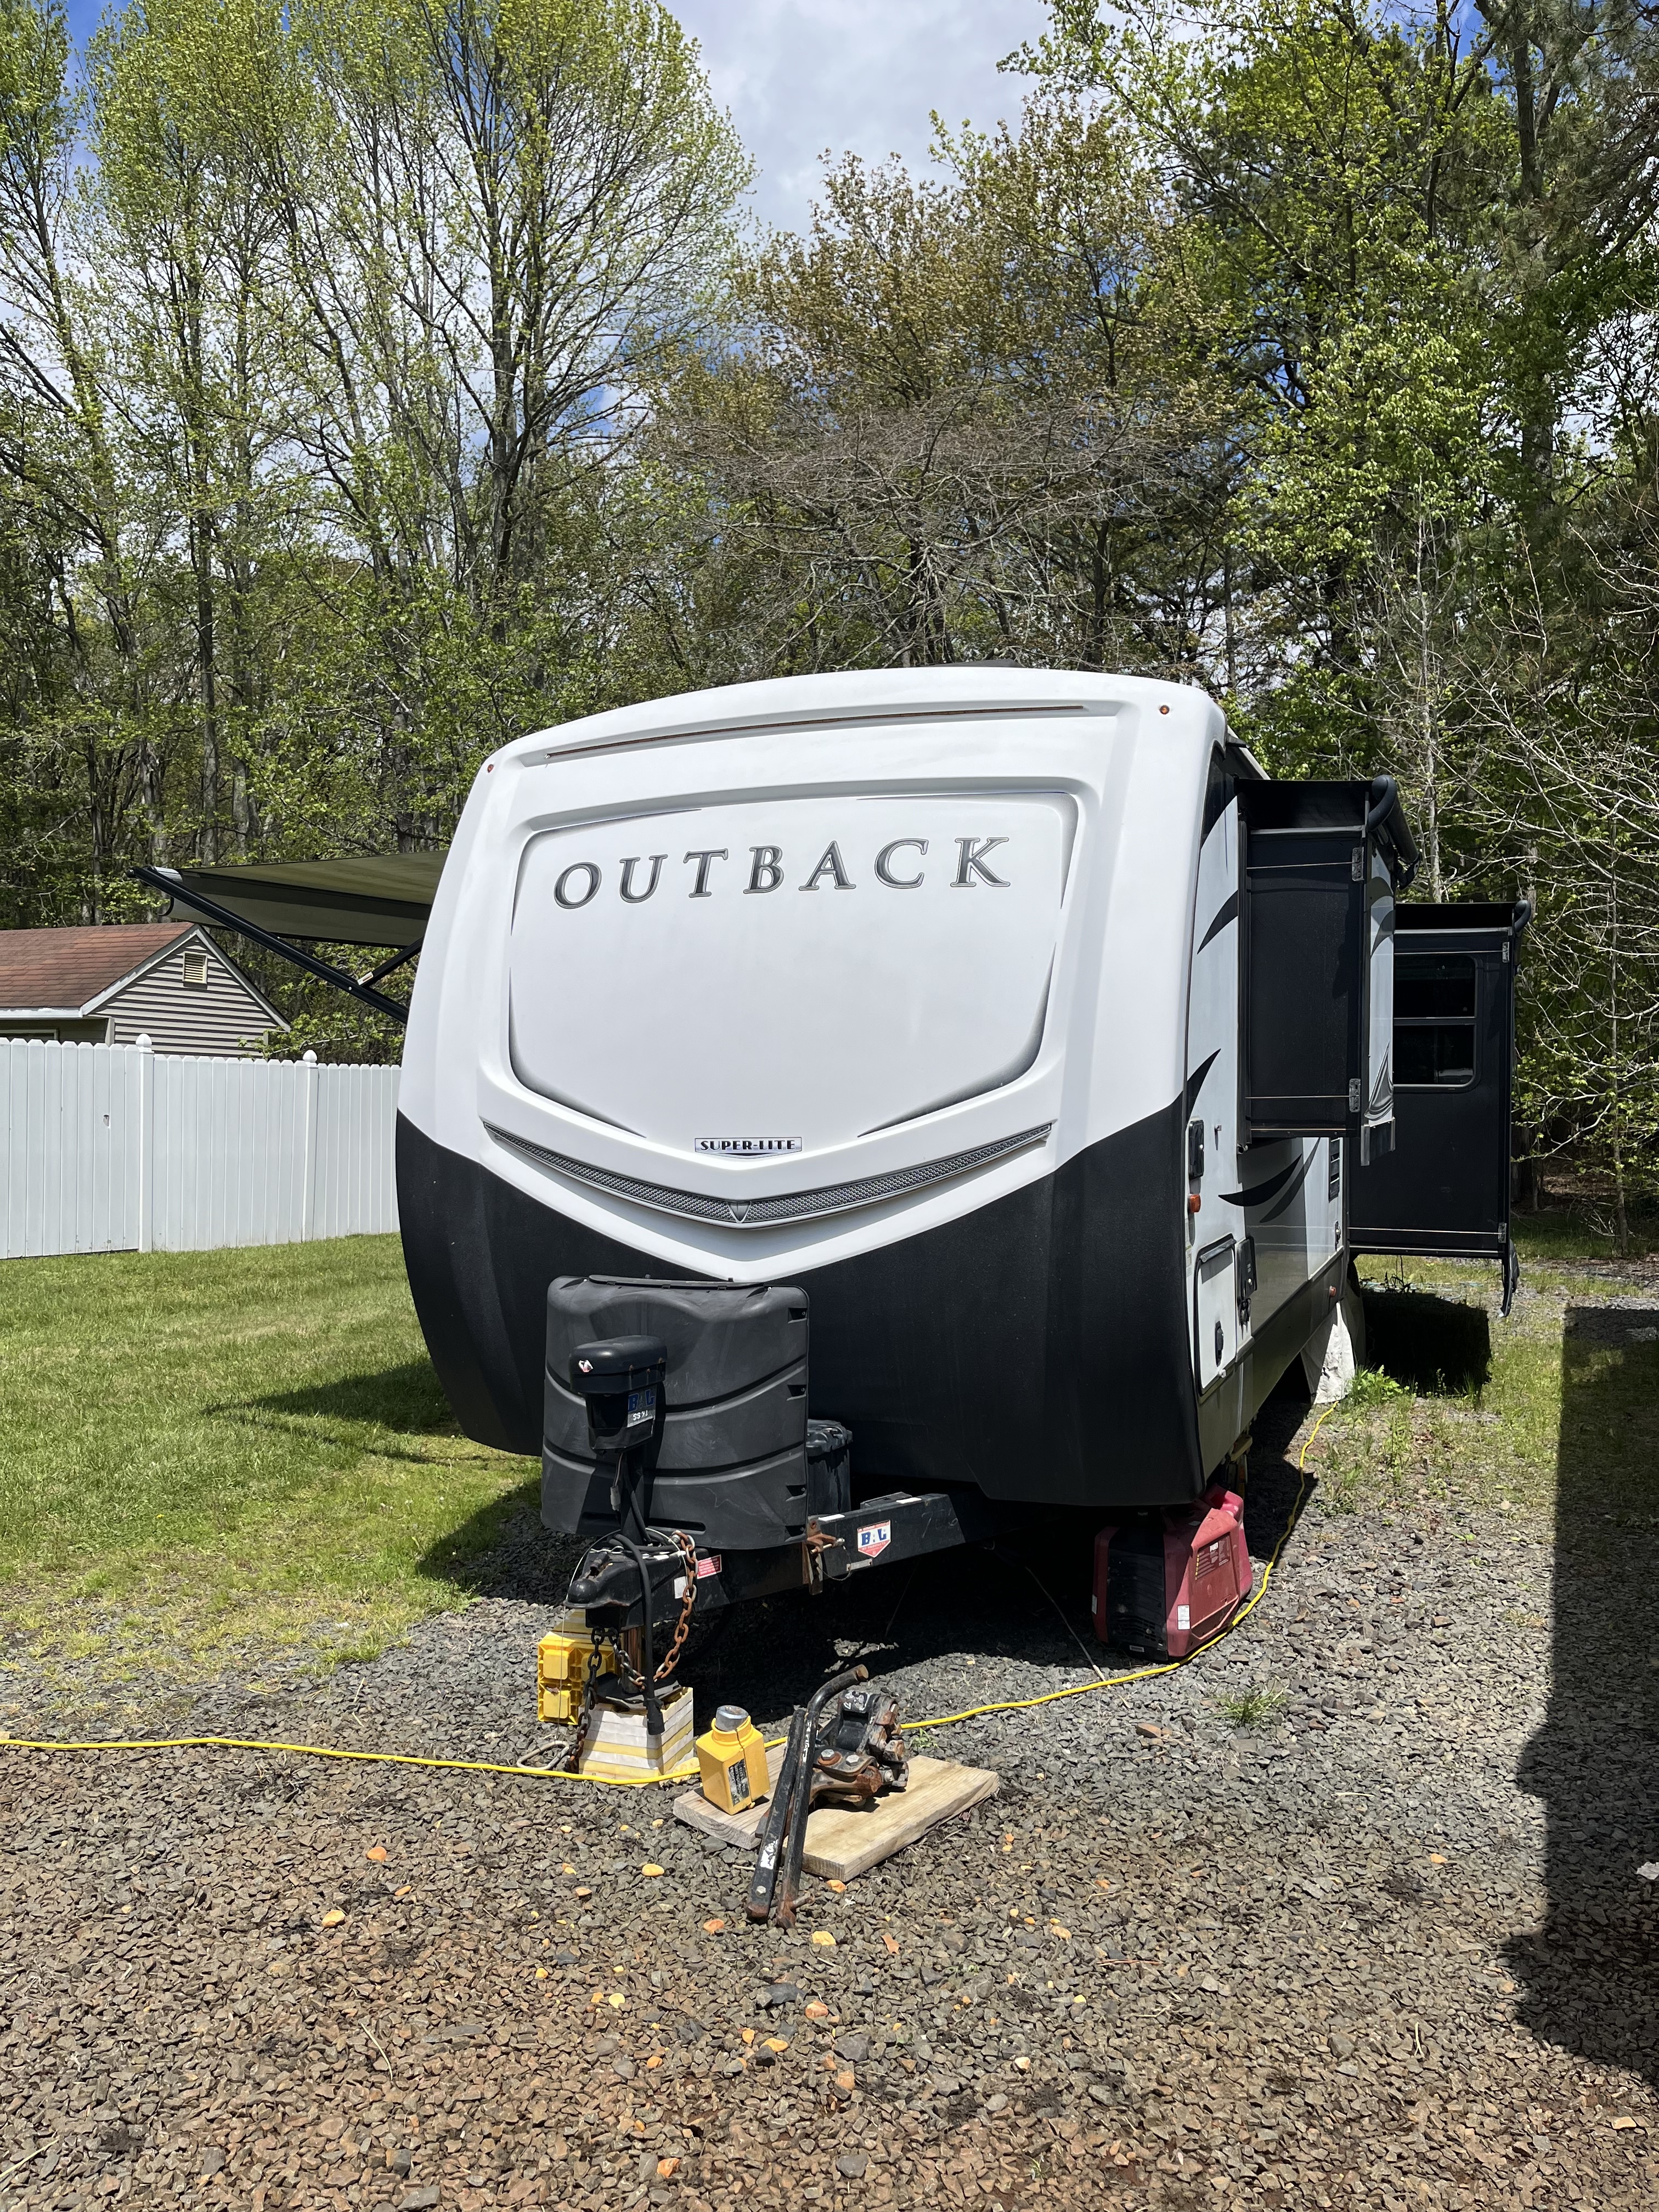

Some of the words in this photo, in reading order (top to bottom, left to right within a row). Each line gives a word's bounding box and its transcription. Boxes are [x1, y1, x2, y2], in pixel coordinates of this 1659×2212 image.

[554, 837, 1011, 910] OUTBACK
[700, 1139, 795, 1151] SUPER-LITE
[628, 1389, 655, 1413] BL
[861, 1528, 887, 1546] BL
